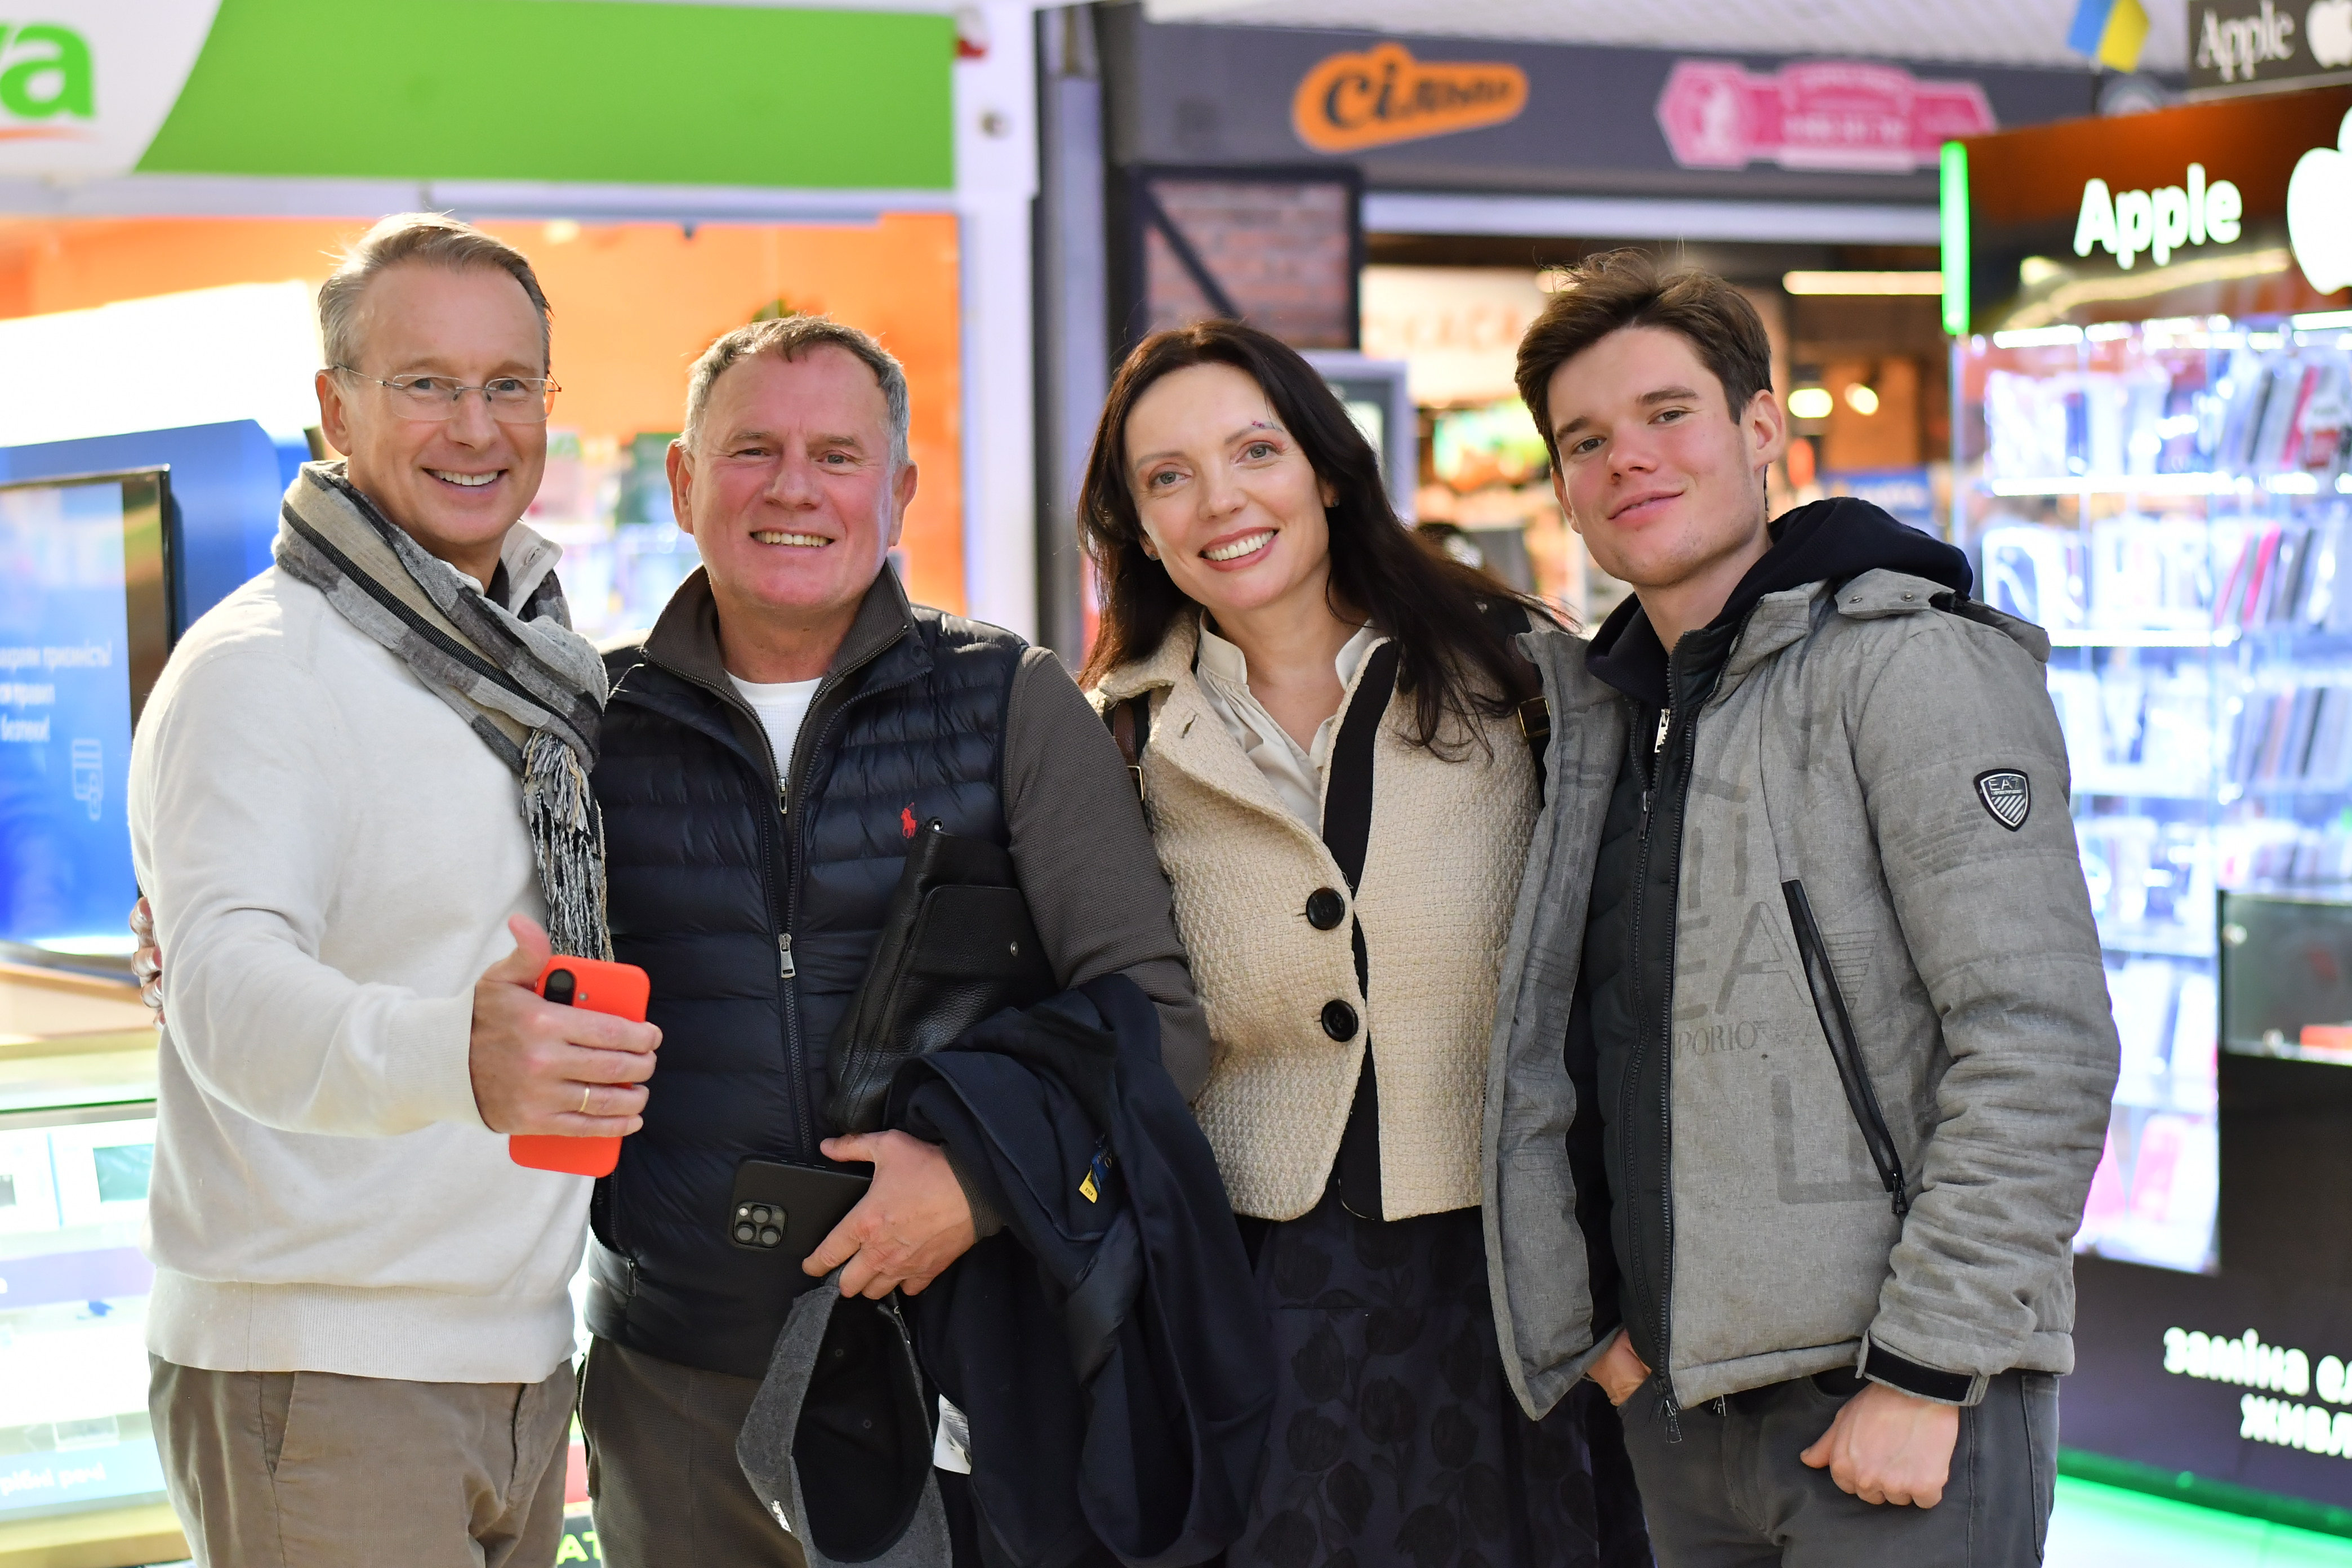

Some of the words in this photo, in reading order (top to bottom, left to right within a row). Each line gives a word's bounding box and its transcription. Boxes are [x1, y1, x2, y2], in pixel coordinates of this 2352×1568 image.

[0, 24, 95, 118] a
[2197, 0, 2295, 82] Apple
[2074, 163, 2242, 270] Apple
[1988, 777, 2020, 791] EA7
[2163, 1326, 2310, 1397] заміна
